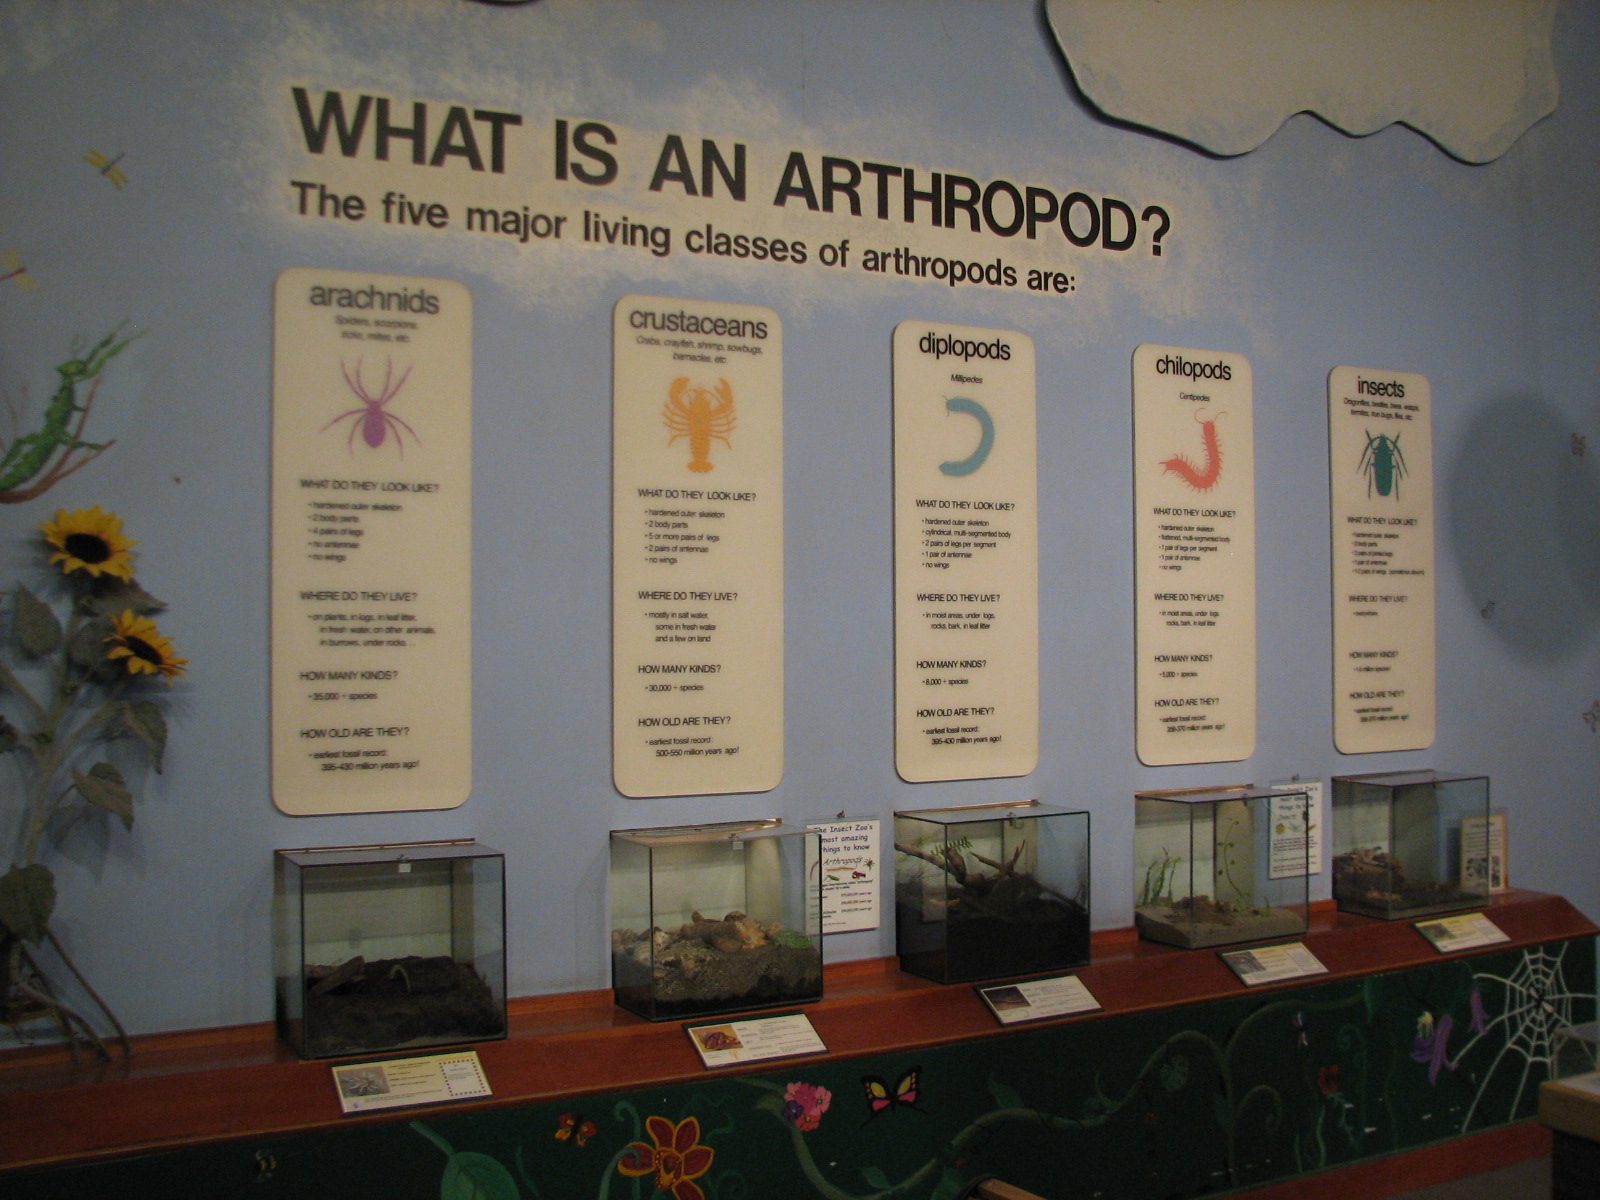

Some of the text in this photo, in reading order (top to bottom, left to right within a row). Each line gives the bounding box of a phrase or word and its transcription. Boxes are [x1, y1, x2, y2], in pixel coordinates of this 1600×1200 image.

[291, 87, 1170, 256] WHAT IS AN ARTHROPOD?
[290, 180, 1075, 294] The five major living classes of arthropods are:
[310, 284, 439, 314] arachnids
[630, 310, 767, 339] crustaceans
[919, 332, 1010, 362] diplopods
[1157, 355, 1231, 382] chilopods
[951, 374, 983, 384] Millipedes
[1358, 376, 1405, 397] insects
[300, 480, 439, 493] WHAT DO THEY LOOK LIKE?
[638, 489, 756, 501] WHAT DO THEY LOOK LIKE?
[952, 501, 971, 509] THEY
[974, 502, 994, 510] LOOK
[655, 521, 670, 529] body
[659, 557, 677, 565] wings
[300, 592, 417, 601] WHERE DO THEY LIVE?
[638, 591, 737, 601] WHERE DO THEY LIVE?
[960, 594, 979, 602] THEY
[690, 665, 721, 673] KINDS?
[960, 660, 986, 668] KINDS?
[300, 671, 398, 680] HOW MANY KINDS?
[638, 716, 731, 726] HOW OLD ARE THEY?
[300, 727, 409, 738] HOW OLD ARE THEY?
